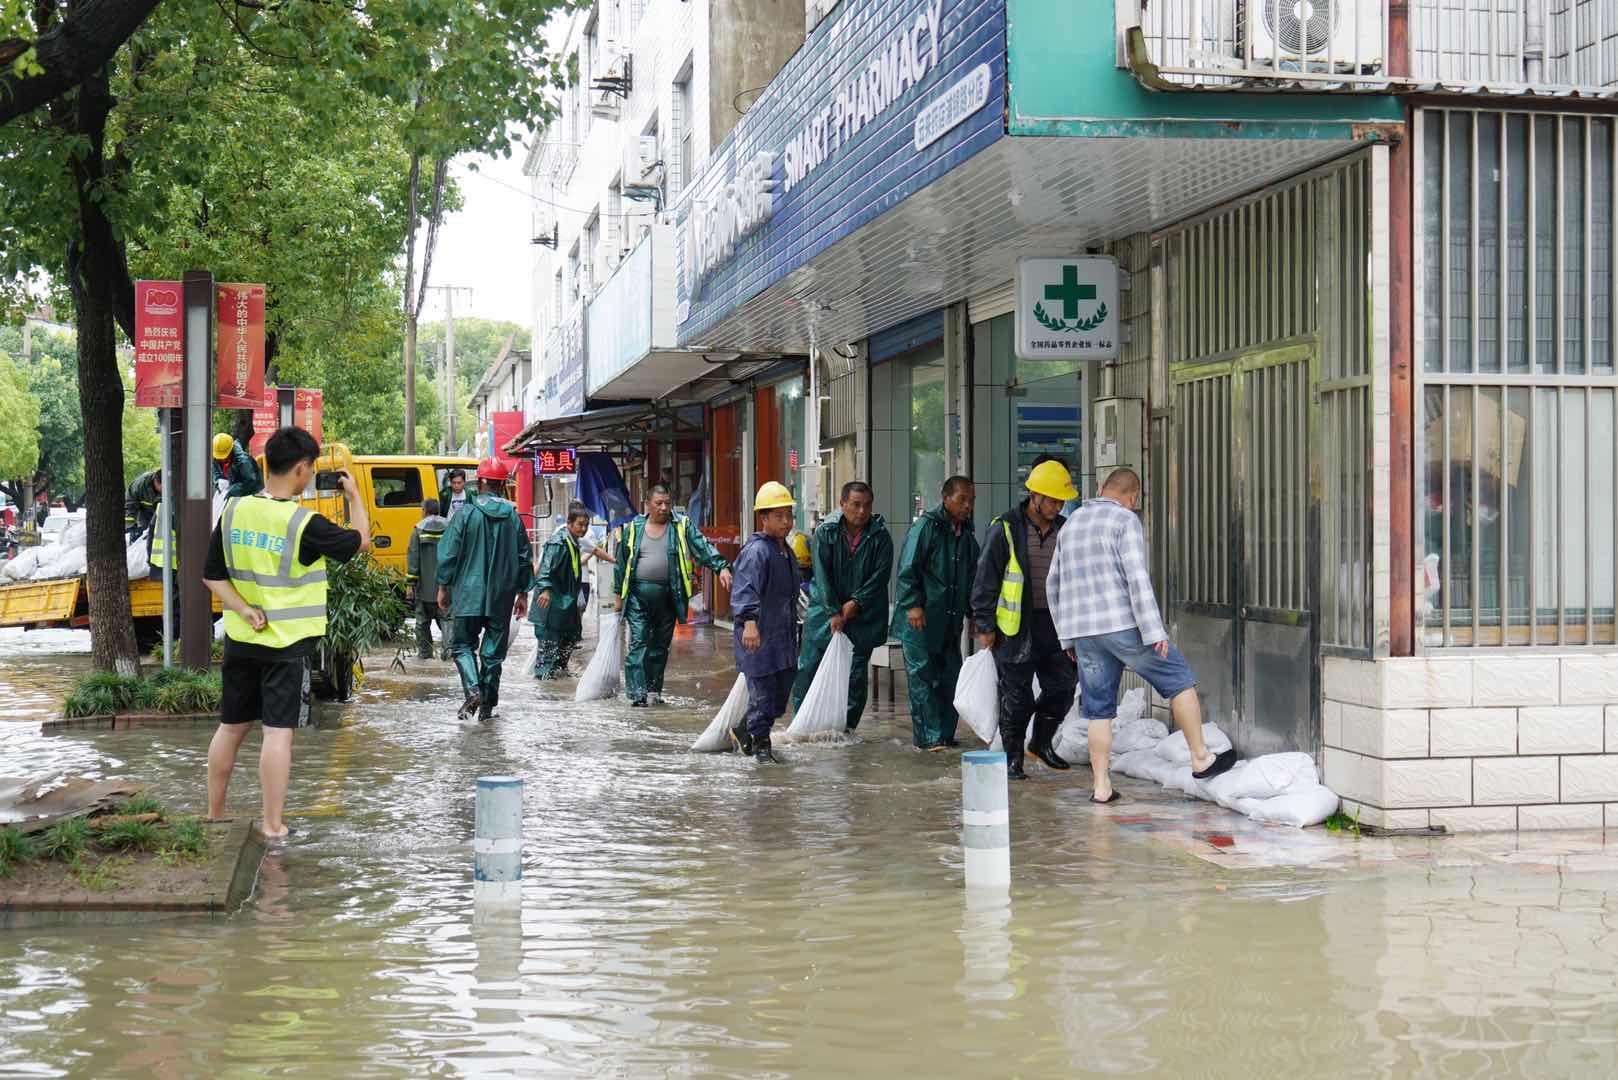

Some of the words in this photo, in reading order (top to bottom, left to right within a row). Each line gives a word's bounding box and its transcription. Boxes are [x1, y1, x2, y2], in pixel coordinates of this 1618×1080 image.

[783, 106, 832, 193] SMART
[834, 0, 944, 150] PHARMACY
[144, 327, 178, 338] 热烈庆祝
[140, 339, 182, 351] 中国共产党
[539, 450, 574, 471] 渔具
